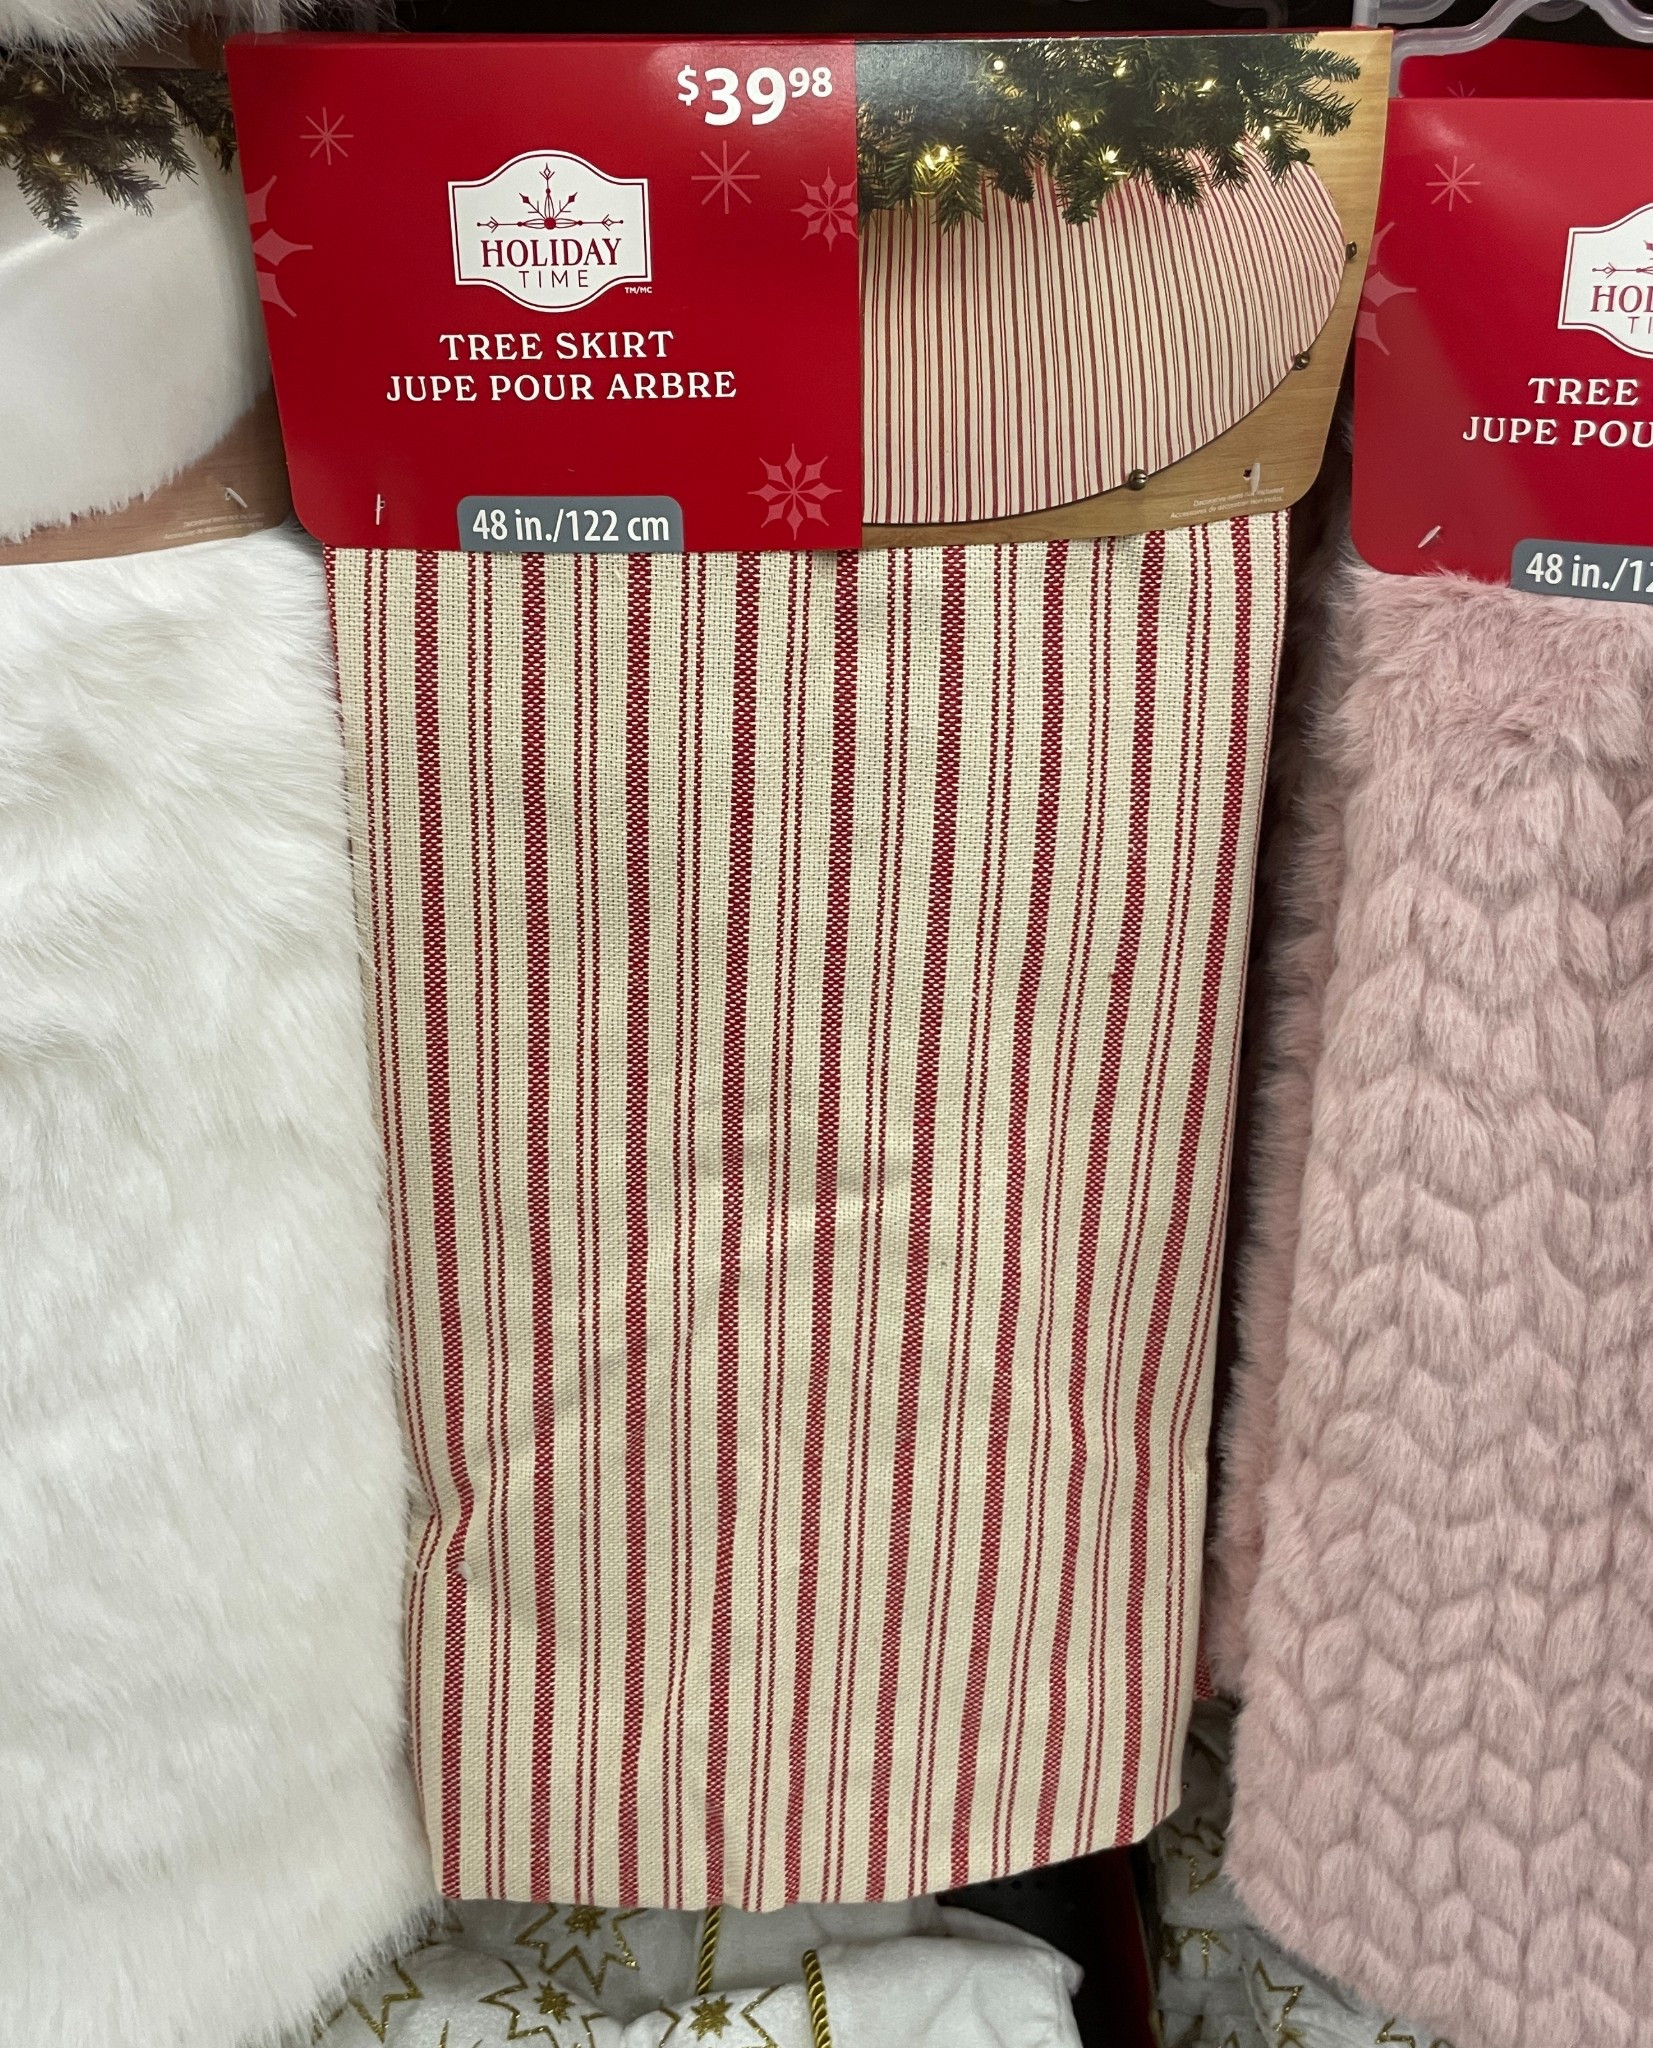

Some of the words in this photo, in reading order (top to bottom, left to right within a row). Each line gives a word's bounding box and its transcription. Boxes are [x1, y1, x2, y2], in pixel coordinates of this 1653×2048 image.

[480, 238, 622, 267] HOLIDAY
[519, 270, 589, 288] TIME
[624, 286, 653, 295] TM/MC
[439, 333, 543, 361] TREE
[556, 330, 674, 360] SKIRT
[386, 374, 478, 402] JUPE
[489, 373, 595, 402] POUR
[606, 371, 737, 400] ARBRE
[1528, 377, 1639, 406] TREE
[1462, 416, 1558, 445] JUPE
[472, 509, 508, 540] 48
[514, 508, 619, 543] in./122
[627, 516, 670, 541] cm
[1526, 552, 1563, 585] 48
